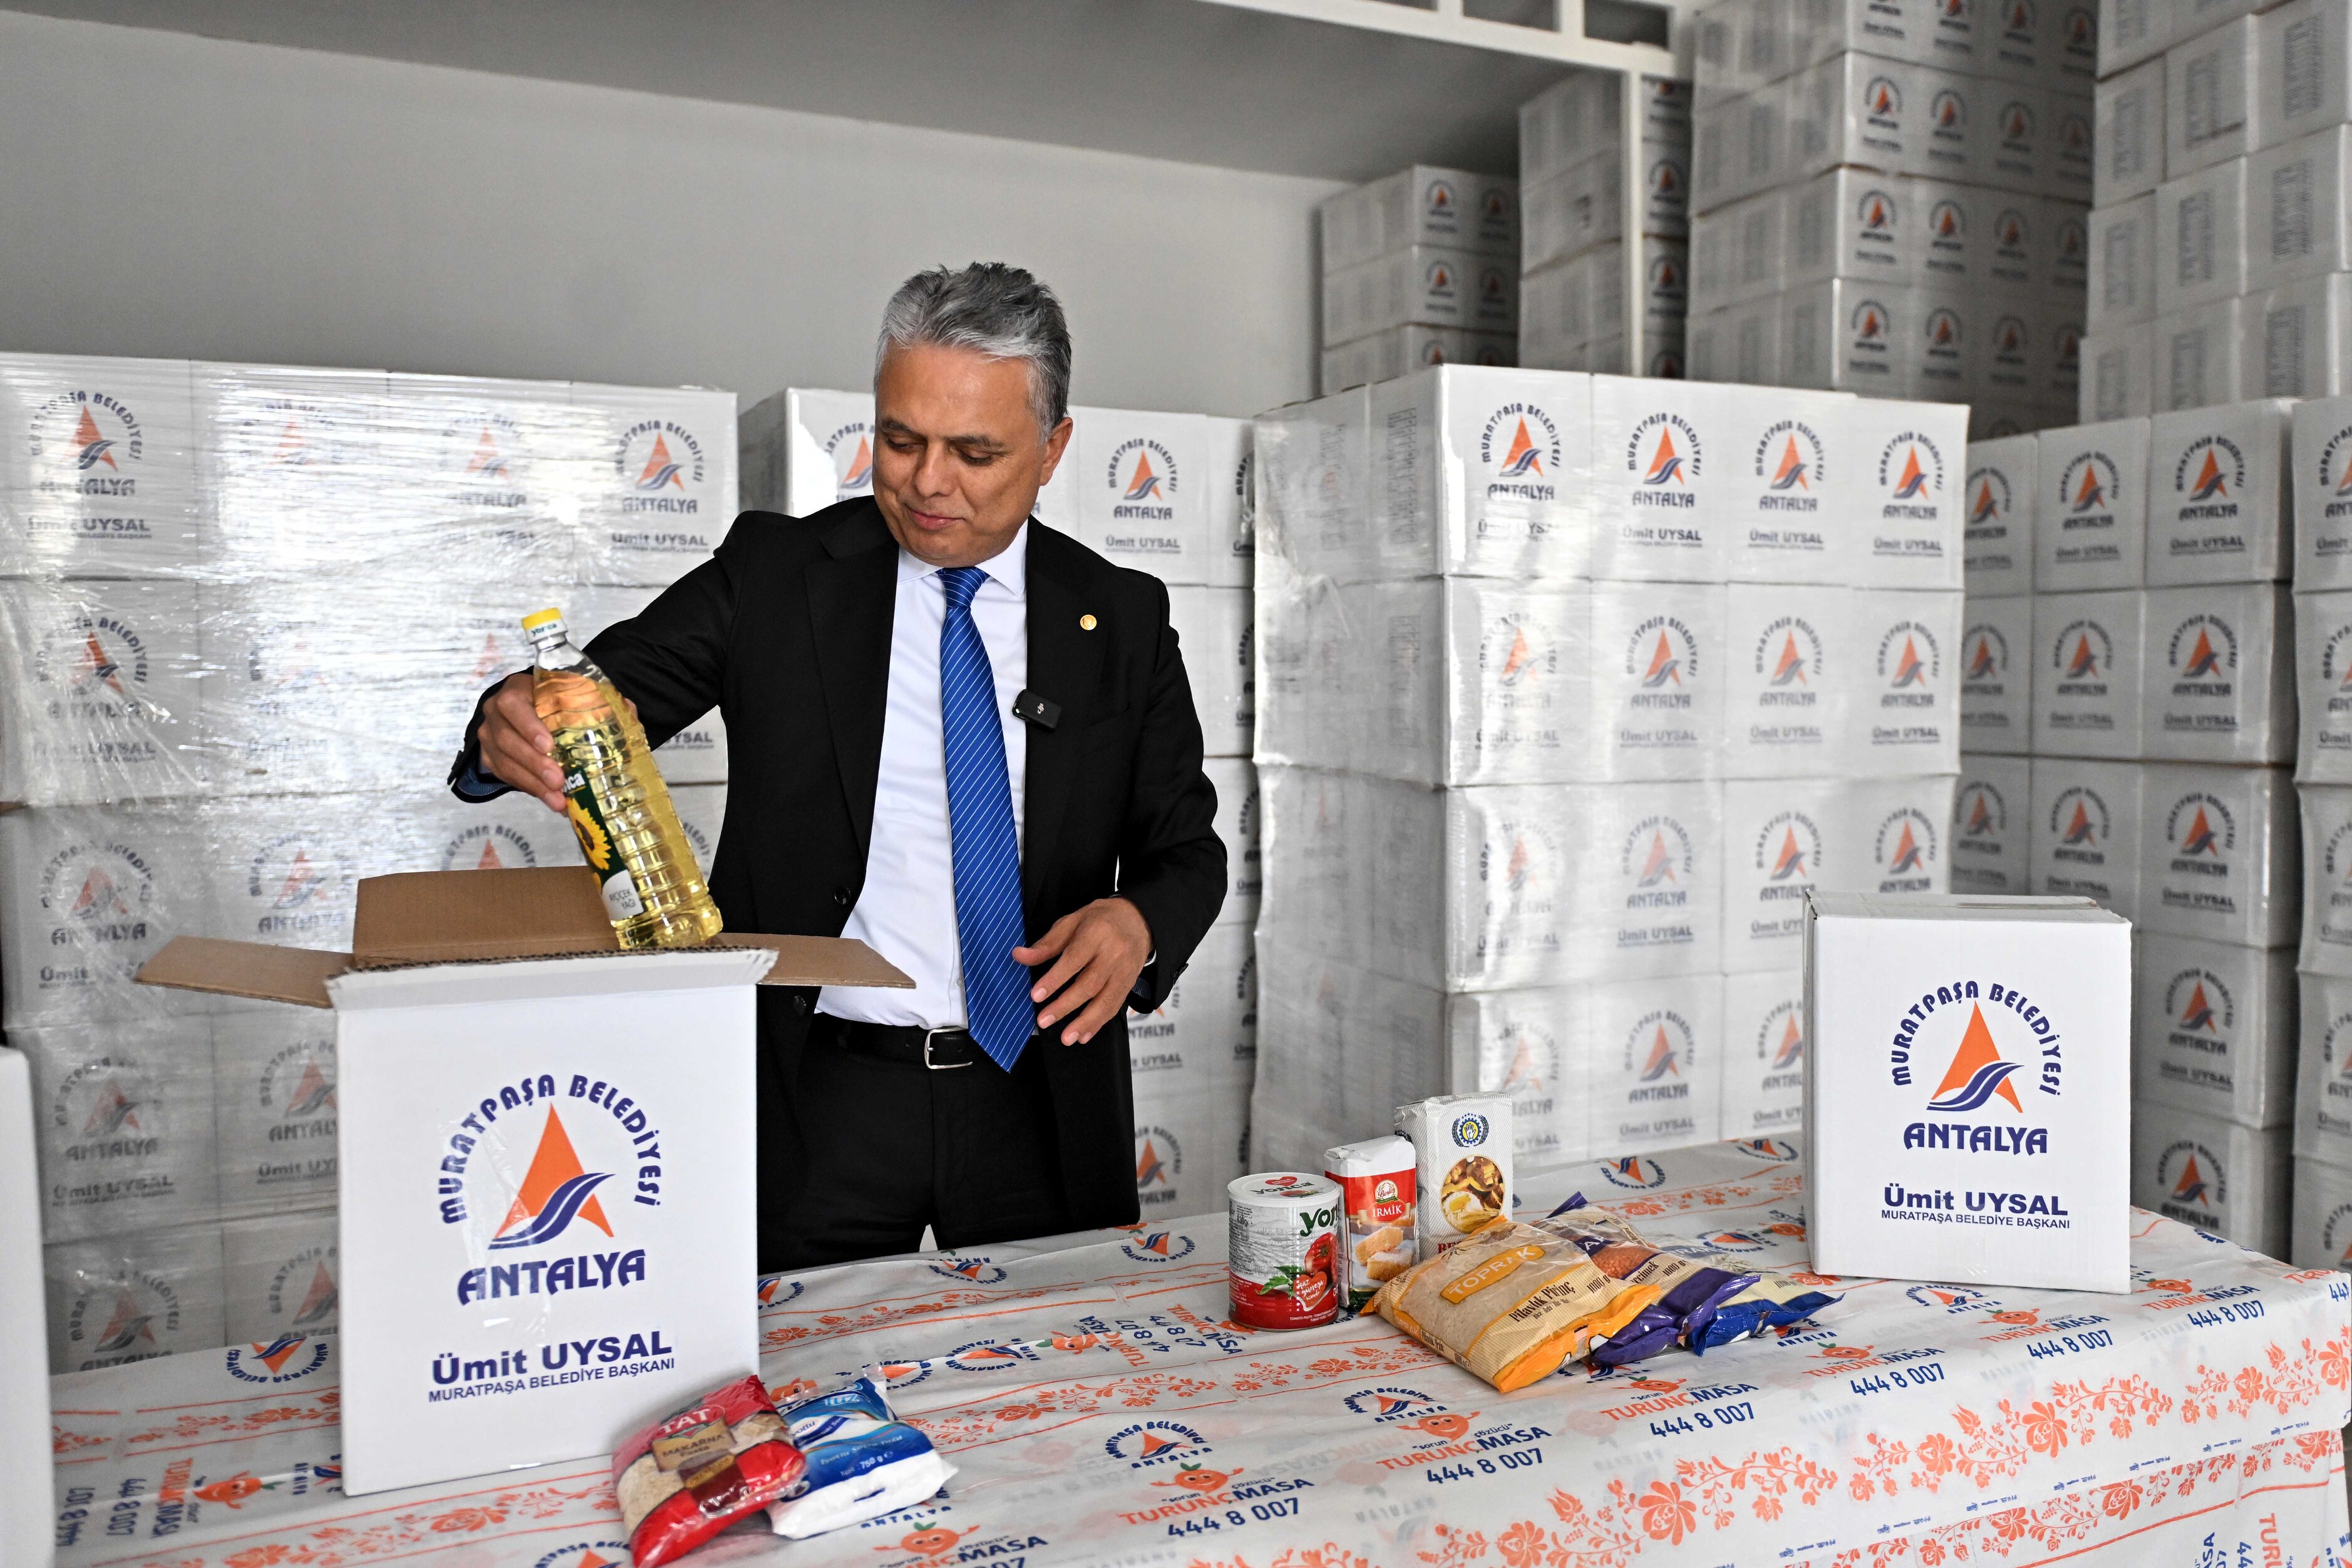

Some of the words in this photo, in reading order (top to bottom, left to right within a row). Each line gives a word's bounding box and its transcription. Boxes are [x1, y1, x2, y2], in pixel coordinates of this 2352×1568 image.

[1488, 484, 1554, 500] ANTALYA
[1632, 491, 1694, 508] ANTALYA
[1114, 505, 1173, 520] ANTALYA
[1760, 496, 1817, 512] ANTALYA
[83, 518, 150, 532] UYSAL
[1658, 528, 1701, 541] UYSAL
[655, 534, 708, 546] UYSAL
[1105, 535, 1134, 547] Ümit
[1140, 537, 1180, 549] UYSAL
[1783, 531, 1823, 544] UYSAL
[1906, 539, 1942, 551] UYSAL
[1631, 694, 1690, 709] ANTALYA
[1655, 730, 1697, 741] UYSAL
[1890, 981, 1979, 1086] MURATPAŞA
[1989, 983, 2061, 1096] BELEDİYESİ
[1629, 1083, 1689, 1103] ANTALYA
[269, 1118, 337, 1142] ANTAL
[1904, 1122, 2048, 1156] ANTALYA
[438, 1074, 555, 1224] MURATPAŞA
[569, 1074, 661, 1206] BELEDİYESİ
[1250, 1181, 1315, 1195] yonca
[1884, 1182, 1954, 1210] Ümit
[1966, 1192, 2068, 1216] UYSAL
[1372, 1204, 1403, 1217] İRMİK
[1881, 1210, 1952, 1224] MURATPAŞA
[1956, 1213, 2013, 1226] BELEDİYE
[2017, 1217, 2070, 1230] BAŞKANI
[457, 1249, 646, 1306] ANTALYA
[1663, 1264, 1681, 1277] 1000
[1586, 1276, 1606, 1294] 1000
[2187, 1309, 2222, 1328] 444
[2222, 1307, 2236, 1322] 8
[2233, 1300, 2265, 1319] 007
[1777, 1331, 1837, 1346] ANTALYA
[2026, 1340, 2064, 1359] 444
[2062, 1337, 2080, 1353] 8
[2078, 1329, 2113, 1349] 007
[432, 1348, 527, 1385] Ümit
[542, 1331, 672, 1369] UYSAL
[428, 1380, 525, 1403] MURATPAŞA
[529, 1368, 604, 1389] BELEDİYE
[609, 1358, 675, 1378] BAŞKANI
[1850, 1375, 1890, 1396] 444
[1889, 1371, 1907, 1388] 8
[1907, 1363, 1944, 1385] 007
[1600, 1383, 1760, 1421] TURUNÇMASA
[659, 1409, 711, 1433] TAT
[1375, 1405, 1448, 1423] ANTALYA
[1650, 1417, 1694, 1437] 444
[1694, 1413, 1713, 1428] 8
[1713, 1402, 1754, 1424] 007
[1132, 1447, 1212, 1469] ANTALYA
[1376, 1426, 1552, 1470] TURUNÇMASA
[859, 1457, 876, 1470] 750
[1427, 1464, 1475, 1484] 444
[1477, 1459, 1497, 1473] 8
[1499, 1448, 1543, 1469] 007
[1119, 1478, 1315, 1525] TURUNÇMASA
[860, 1506, 952, 1529] ANTALYA
[1168, 1516, 1221, 1537] 444
[1226, 1511, 1246, 1525] 8
[1251, 1497, 1299, 1521] 007
